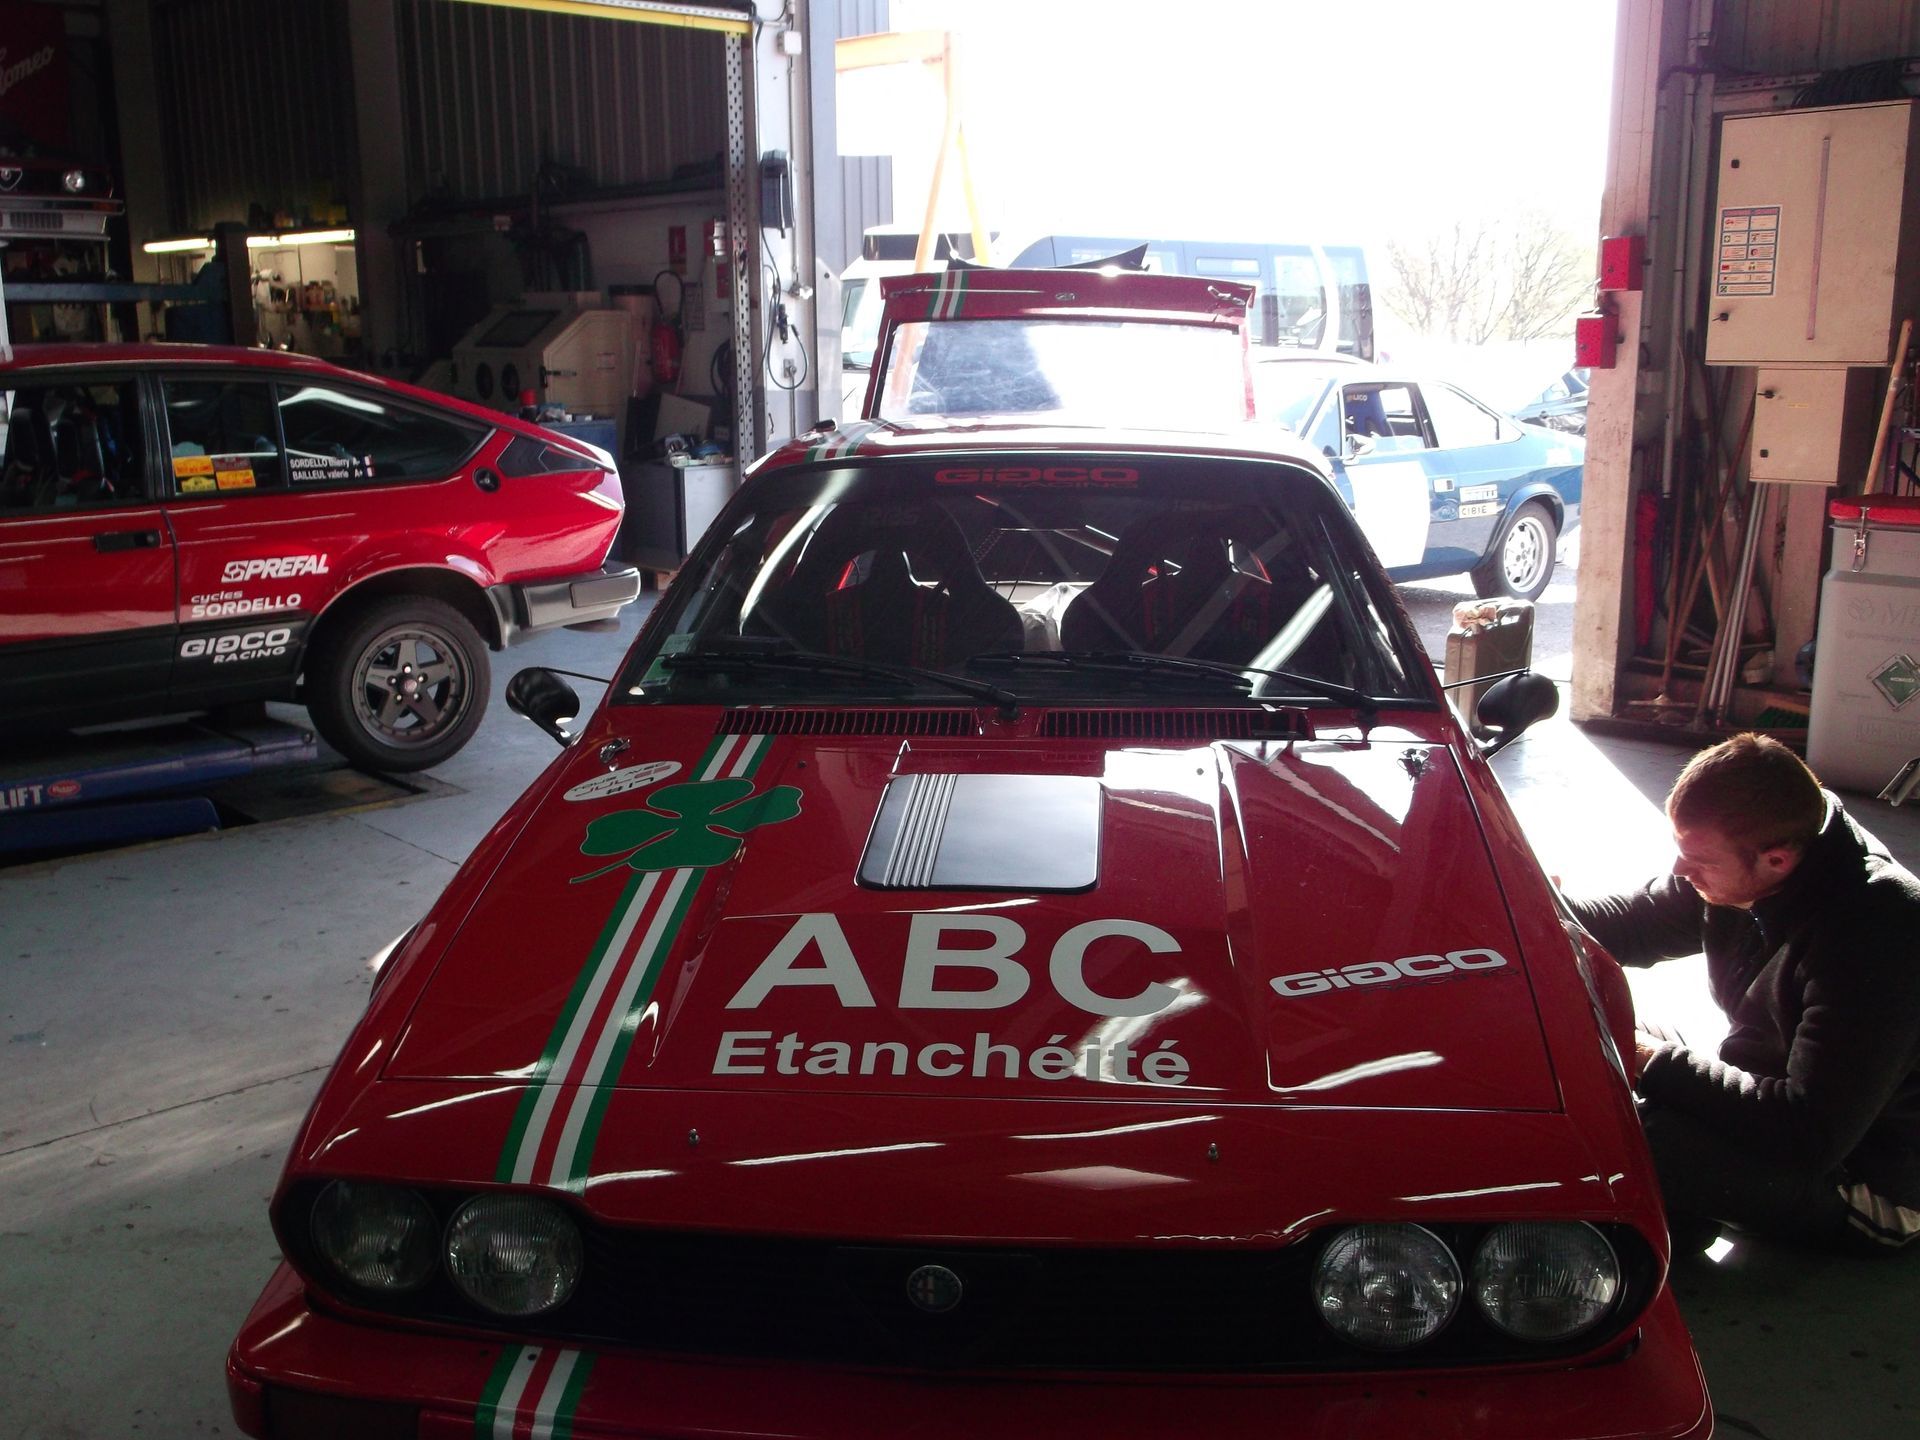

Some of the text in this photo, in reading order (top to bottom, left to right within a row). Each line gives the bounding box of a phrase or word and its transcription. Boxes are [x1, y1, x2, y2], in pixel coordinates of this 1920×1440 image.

[290, 457, 328, 469] SORDELLO
[292, 469, 327, 481] BAILLEUL
[191, 590, 243, 604] cycles
[191, 593, 302, 618] SORDELLO
[213, 646, 287, 664] RACING
[724, 912, 1183, 1018] ABC
[711, 1031, 1191, 1086] Etanchéité
